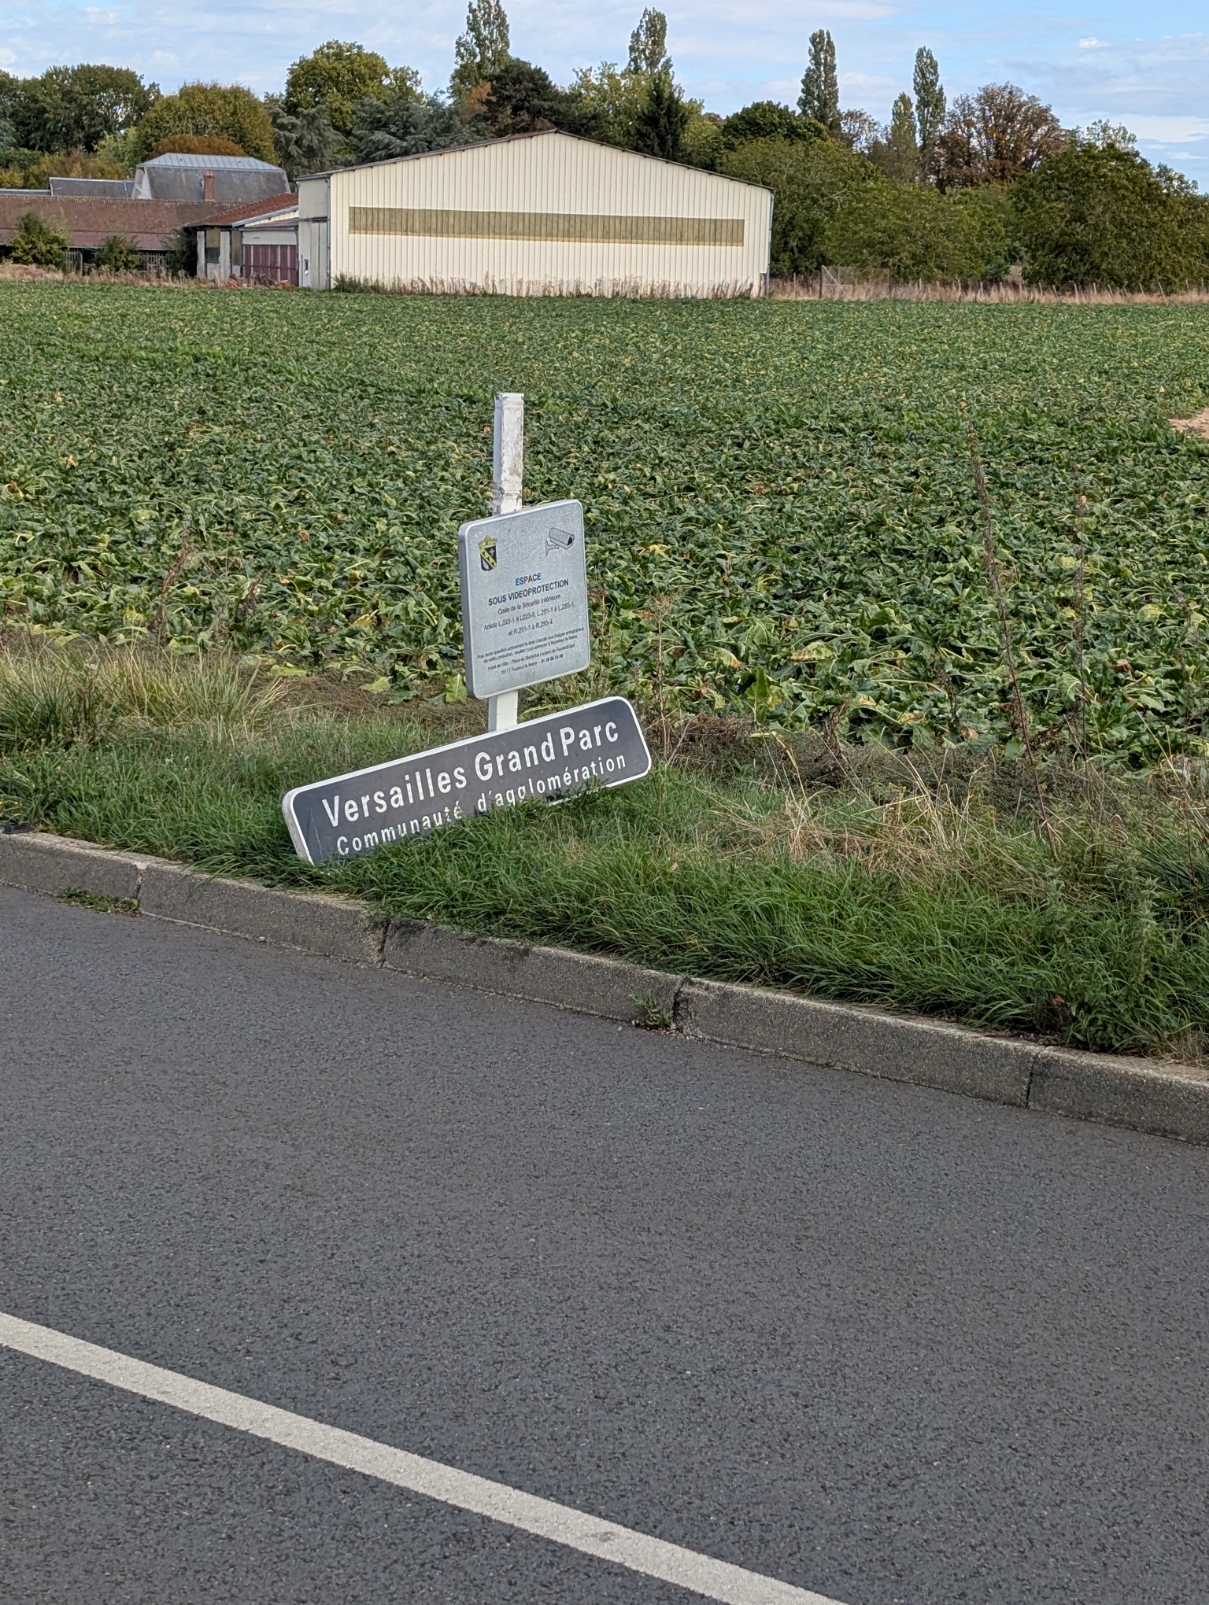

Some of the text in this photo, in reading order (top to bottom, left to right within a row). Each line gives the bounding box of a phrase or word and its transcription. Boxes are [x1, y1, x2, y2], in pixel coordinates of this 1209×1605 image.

[488, 579, 569, 606] SOUS VIDEOPROTECTION
[515, 572, 542, 586] ESPACE
[497, 607, 510, 615] Code
[322, 720, 619, 827] Versailles Grand Parc
[336, 800, 463, 856] Communauté
